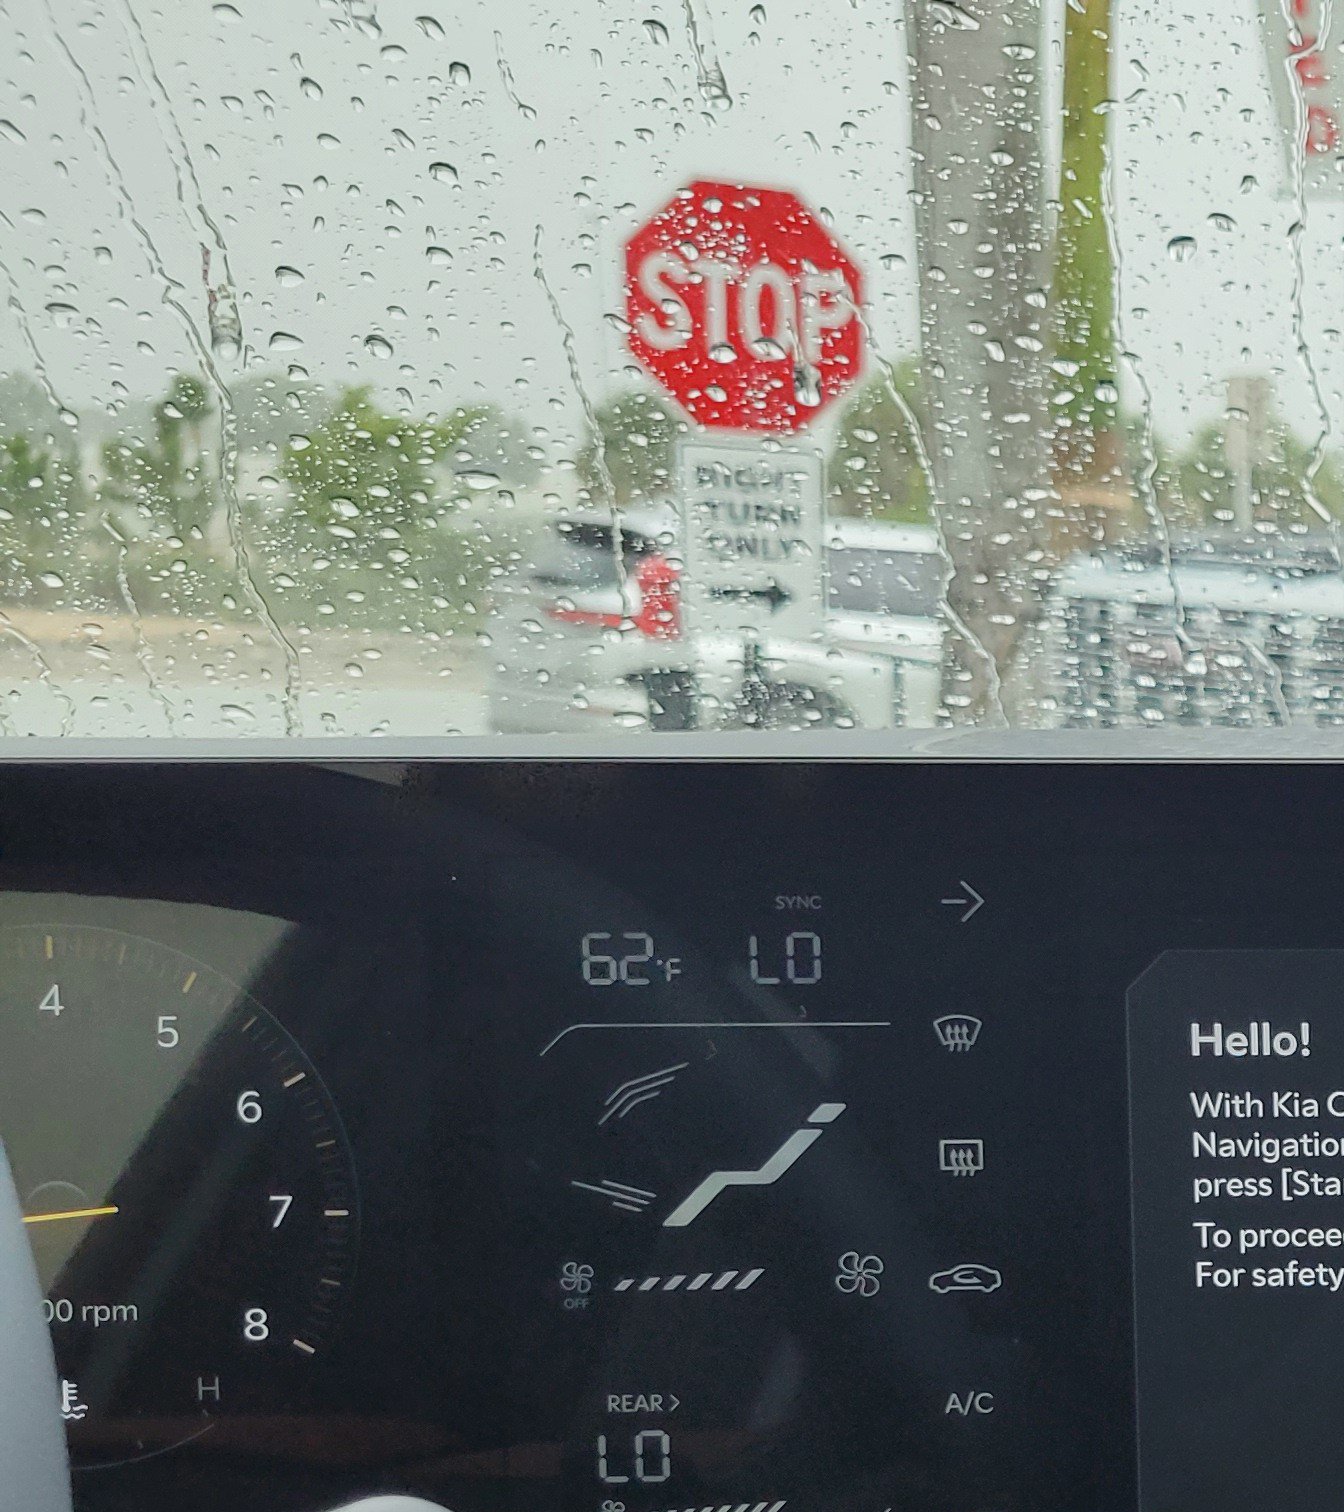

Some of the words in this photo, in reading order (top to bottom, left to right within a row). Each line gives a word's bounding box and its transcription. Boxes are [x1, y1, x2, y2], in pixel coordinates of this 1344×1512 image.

[636, 248, 855, 366] STOP
[774, 895, 822, 910] SYNC
[748, 931, 822, 985] LO
[38, 983, 65, 1017] 4
[157, 1015, 179, 1048] 5
[1190, 1021, 1311, 1057] Hello!
[236, 1090, 262, 1124] 6
[1189, 1091, 1264, 1118] With
[1272, 1091, 1319, 1118] Kia
[1193, 1177, 1273, 1204] press
[269, 1195, 293, 1228] 7
[1192, 1221, 1232, 1249] To
[1196, 1261, 1247, 1288] For
[81, 1304, 138, 1328] rpm
[563, 1297, 589, 1310] OFF
[243, 1307, 269, 1341] 8
[197, 1376, 220, 1401] H
[944, 1390, 994, 1416] A/C
[597, 1429, 671, 1483] LO
